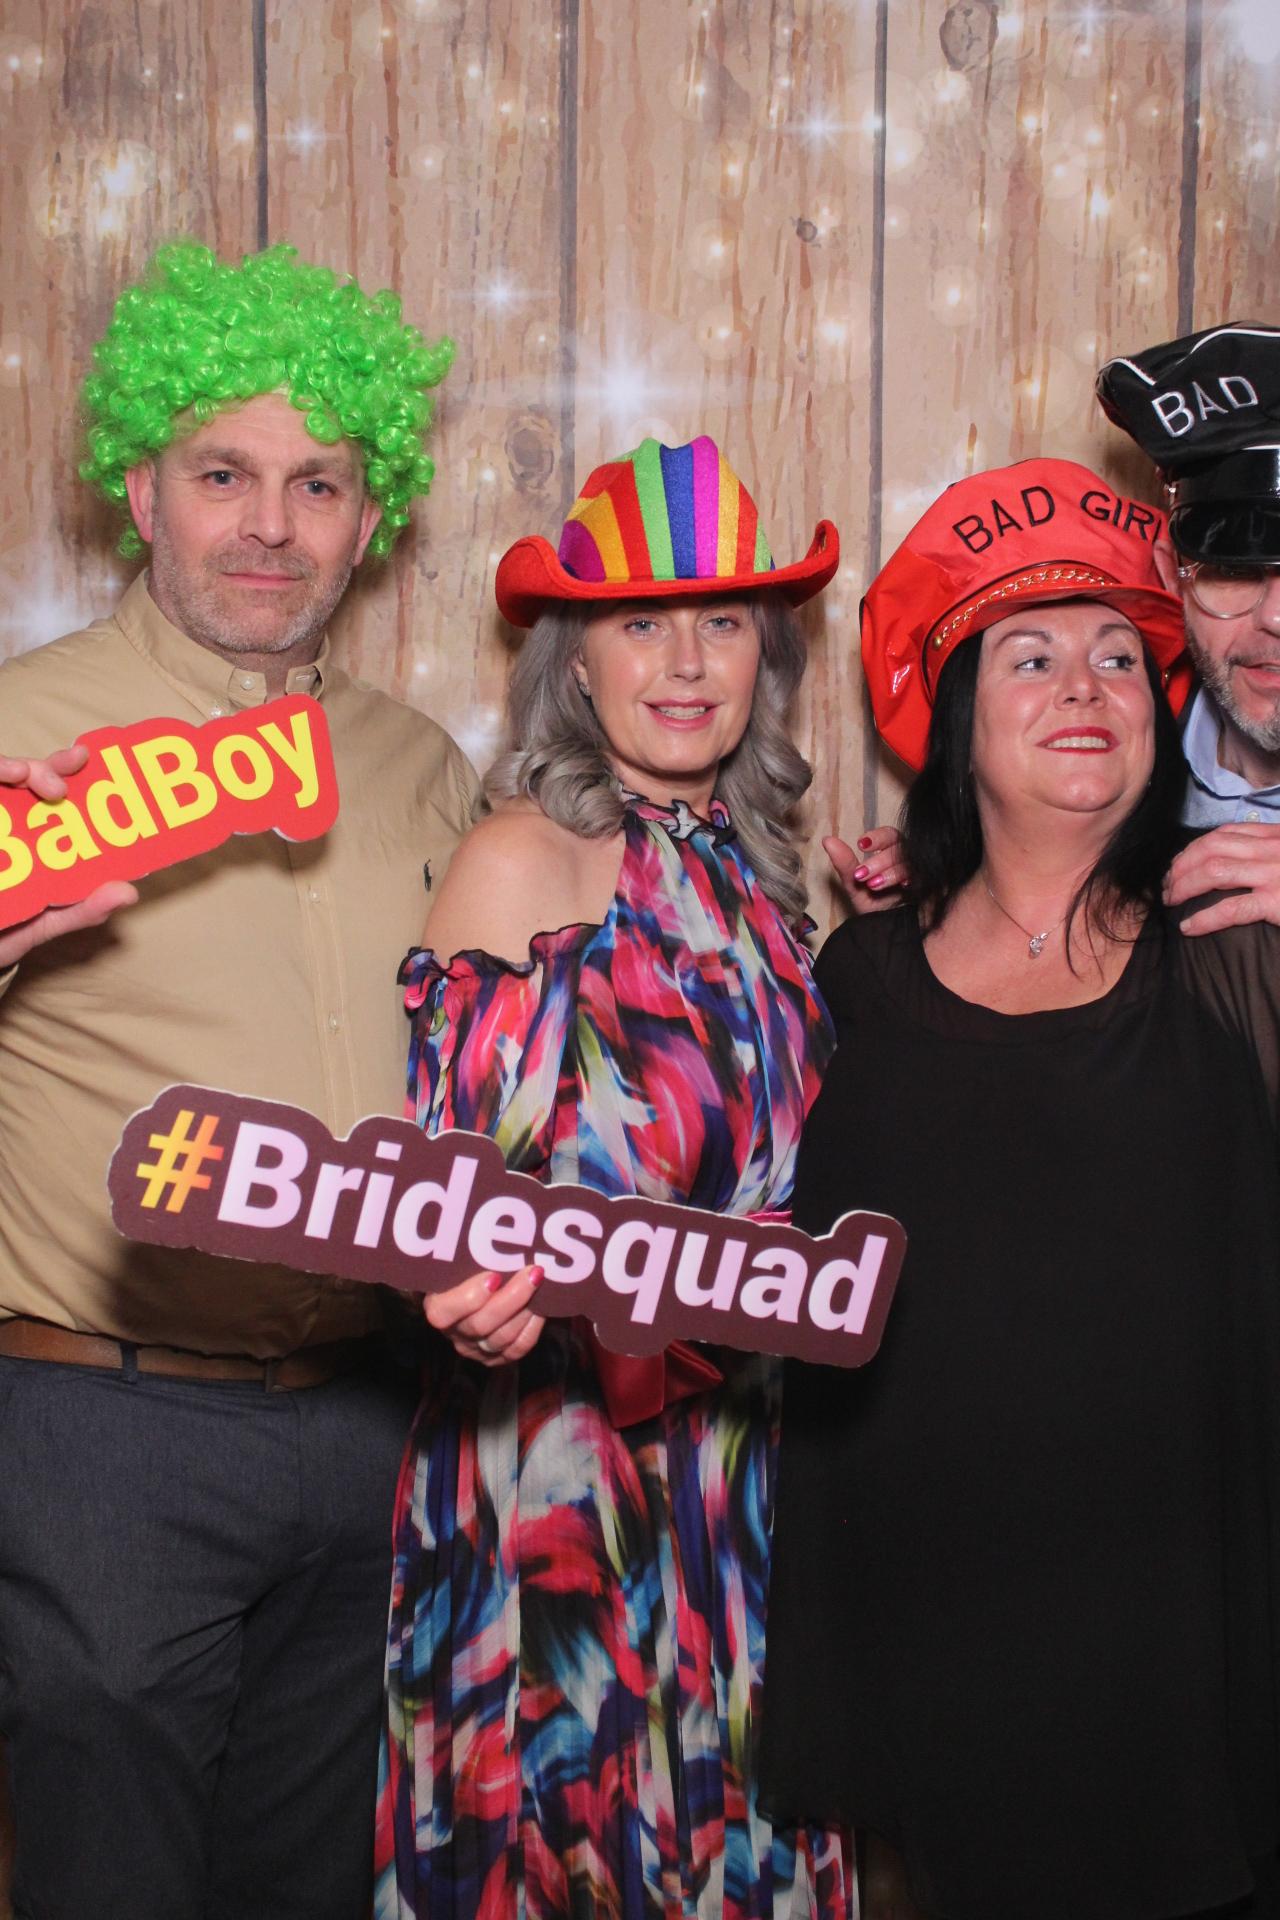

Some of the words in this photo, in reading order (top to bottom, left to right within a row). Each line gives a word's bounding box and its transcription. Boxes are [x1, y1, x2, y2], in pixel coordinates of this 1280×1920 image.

[1152, 376, 1259, 438] BAD
[952, 486, 1055, 554] BAD
[137, 1109, 888, 1334] #Bridesquad
